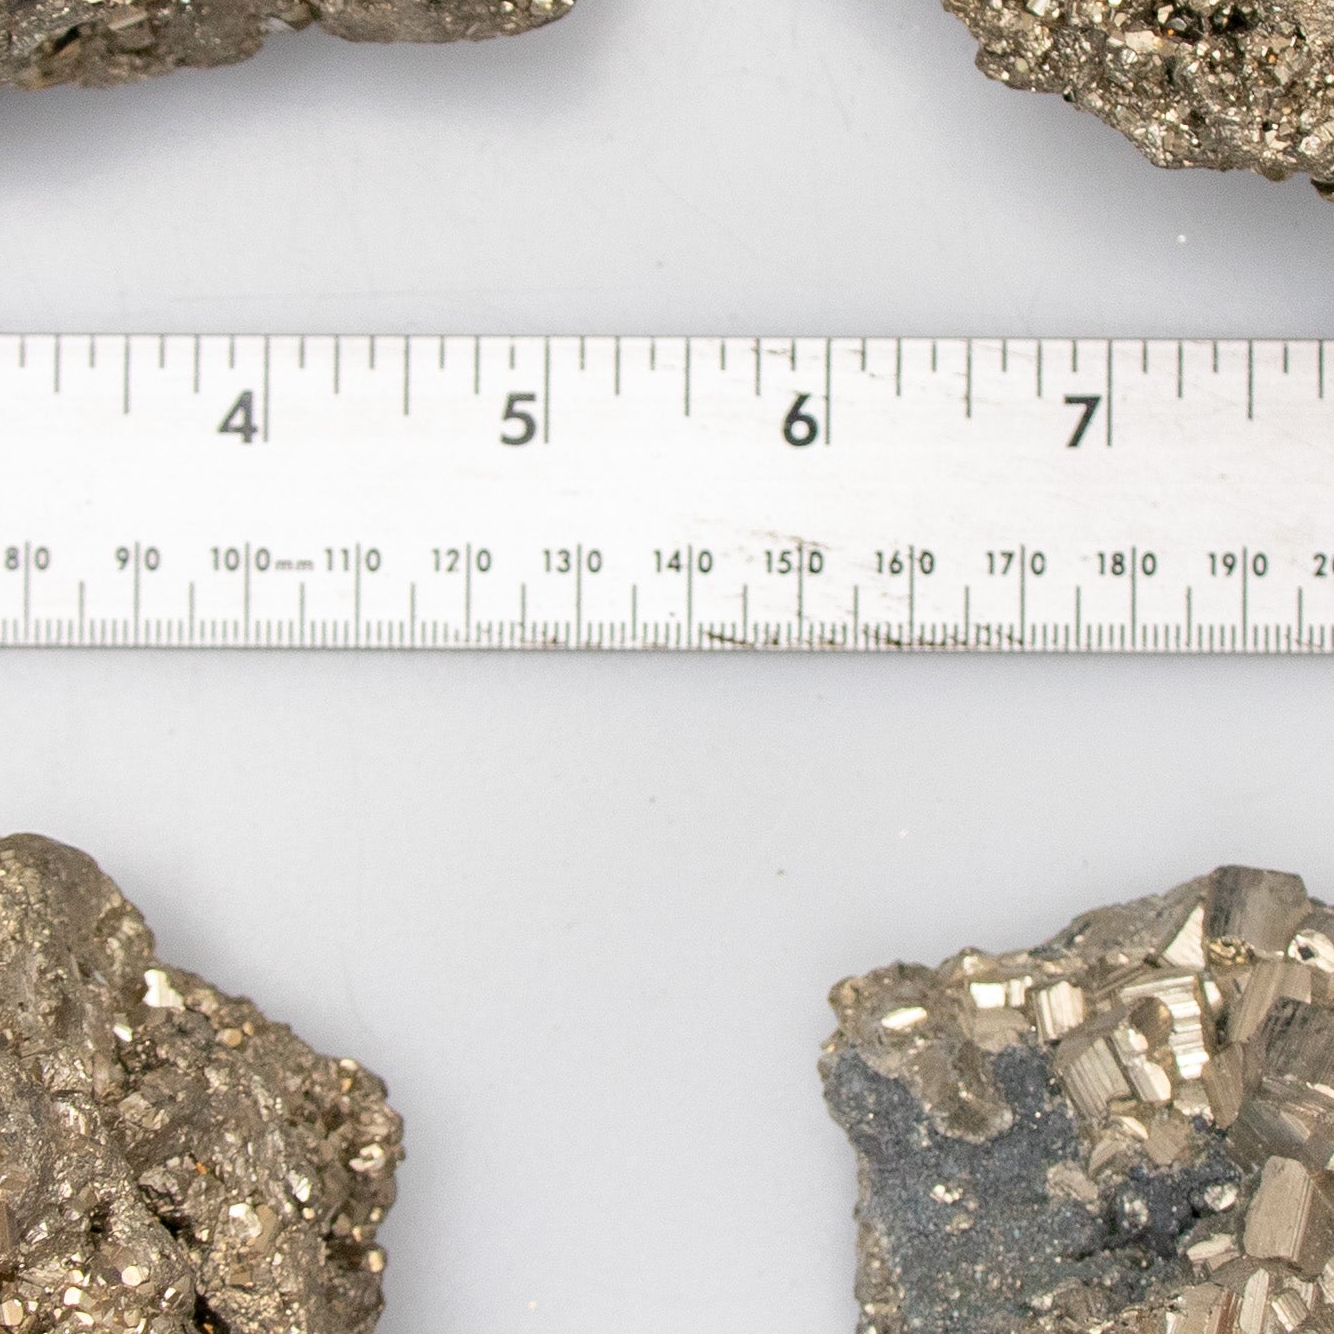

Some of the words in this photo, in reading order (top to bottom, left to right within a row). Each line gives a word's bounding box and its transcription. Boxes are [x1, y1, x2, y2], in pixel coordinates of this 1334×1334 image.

[217, 390, 259, 444] 4
[500, 392, 537, 447] 5
[782, 393, 819, 447] 6
[1064, 395, 1102, 448] 7
[4, 546, 51, 572] 80
[115, 547, 161, 573] 90
[324, 548, 382, 574] 110
[432, 548, 492, 574] 120
[543, 549, 603, 575] 130
[654, 550, 713, 576] 140
[765, 550, 824, 576] 150
[876, 551, 935, 577] 160
[986, 551, 1046, 577] 170
[1097, 552, 1157, 578] 180
[1208, 553, 1269, 579] 190
